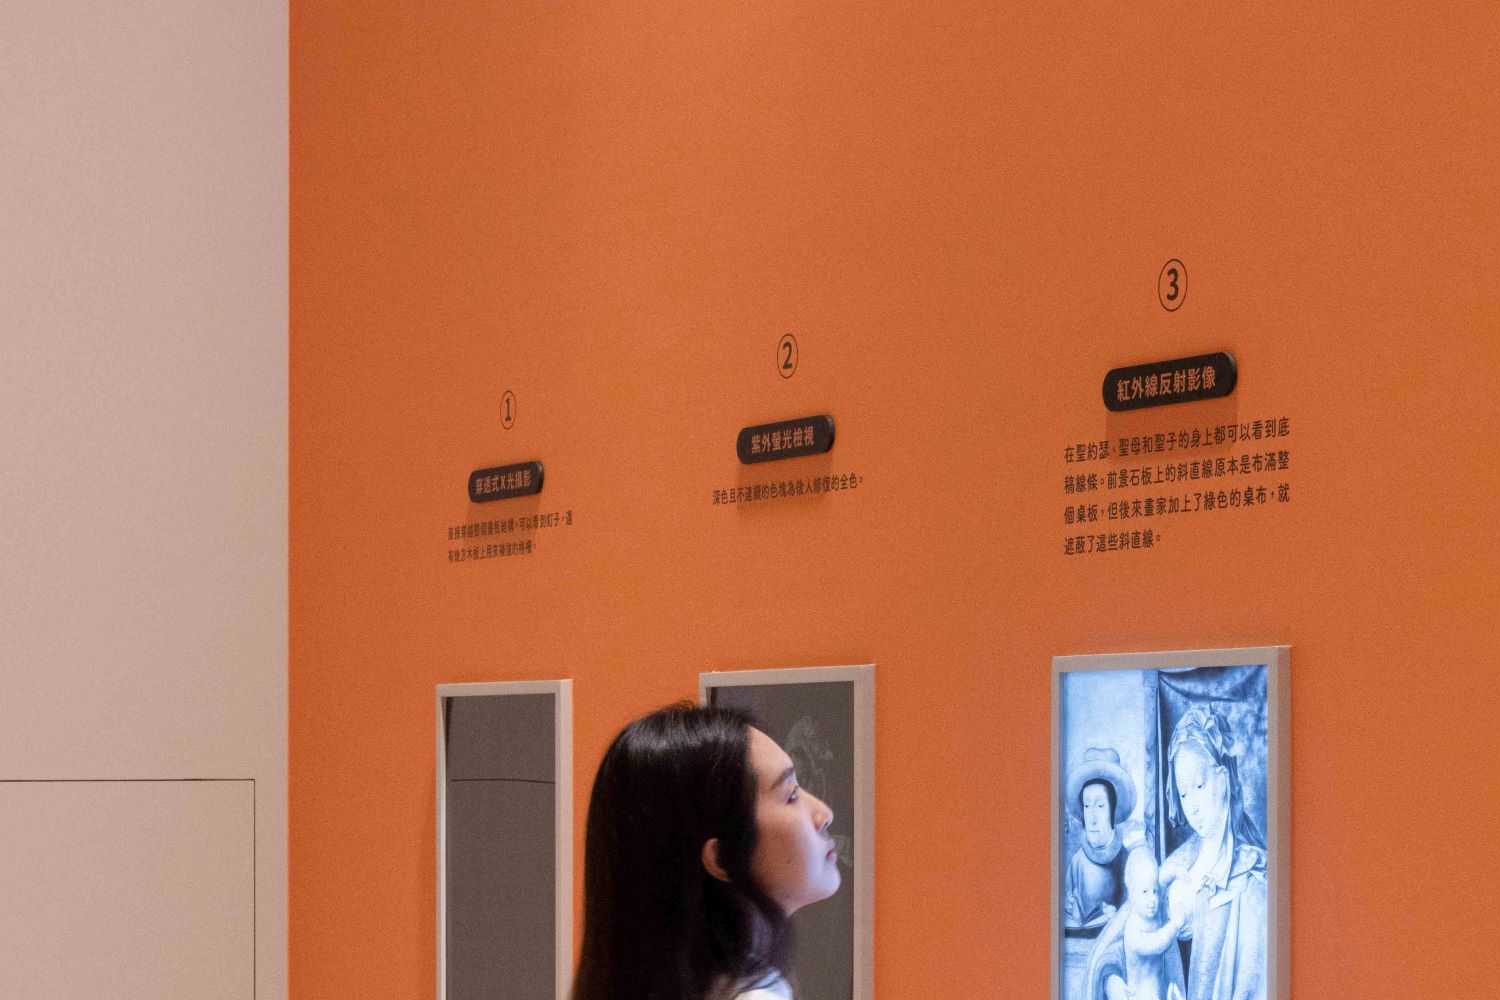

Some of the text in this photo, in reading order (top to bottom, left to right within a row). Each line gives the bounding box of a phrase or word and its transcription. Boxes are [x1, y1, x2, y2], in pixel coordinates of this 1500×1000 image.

[1116, 365, 1217, 402] 紅外線反射影像
